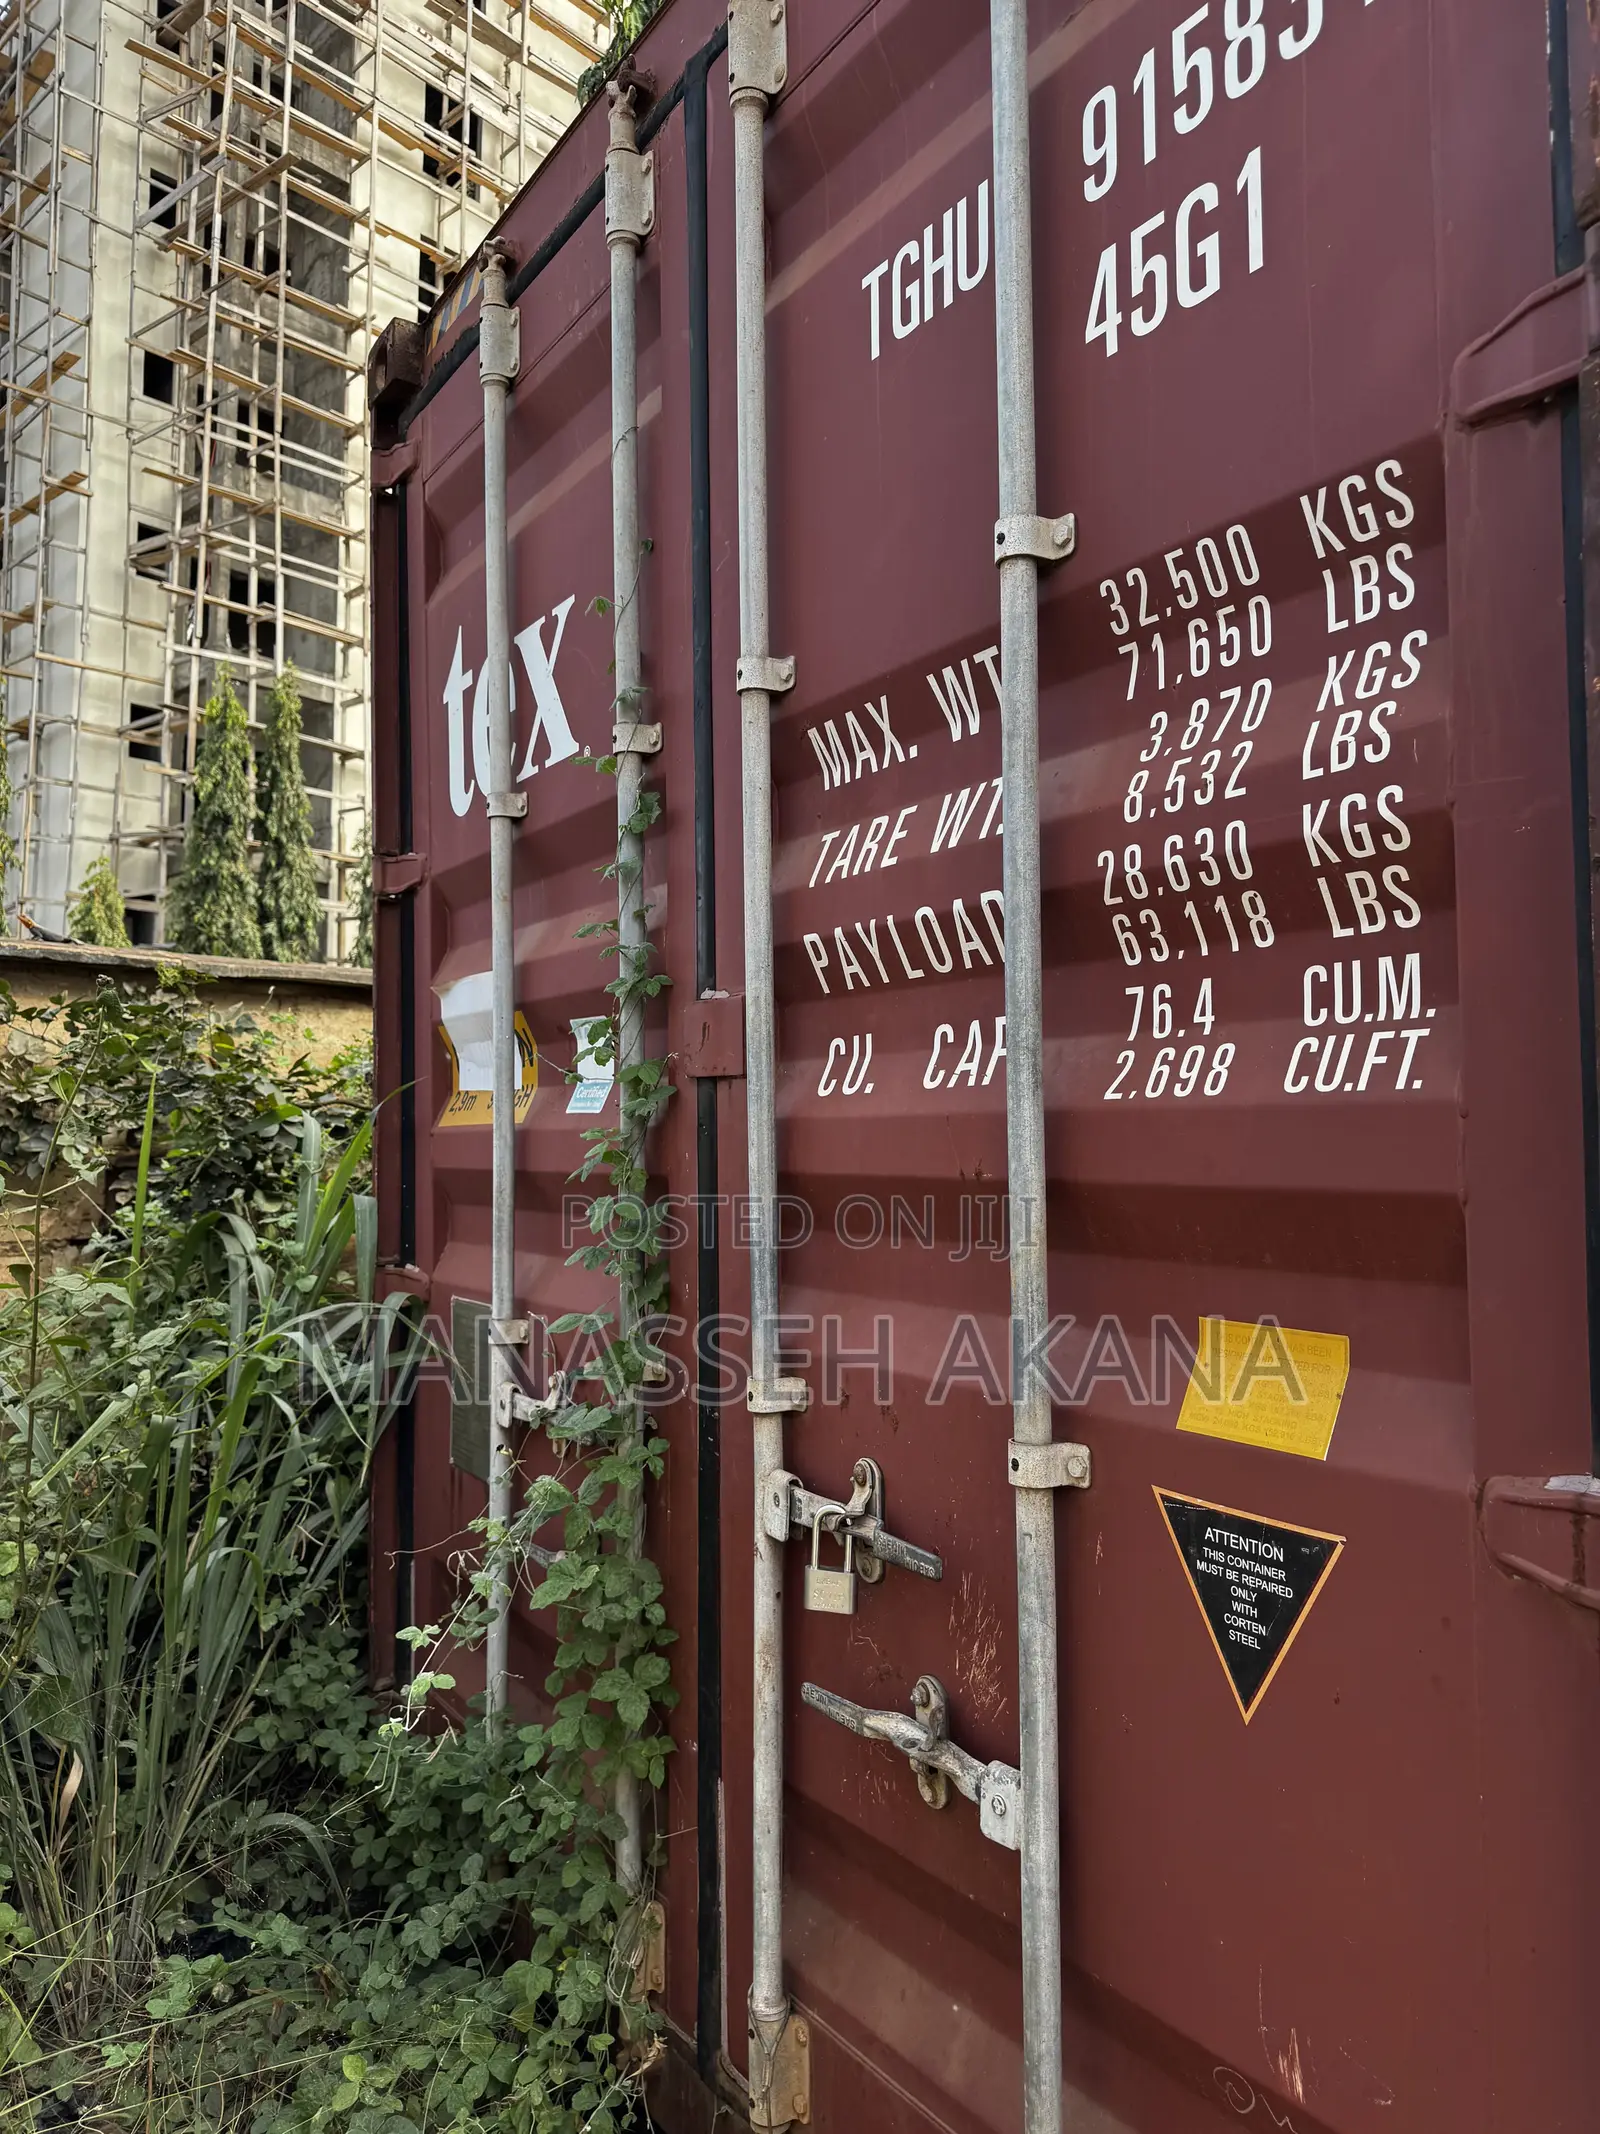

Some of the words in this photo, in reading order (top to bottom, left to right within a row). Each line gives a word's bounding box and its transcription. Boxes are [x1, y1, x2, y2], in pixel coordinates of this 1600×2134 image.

[861, 180, 989, 361] TGHU
[1085, 146, 1264, 358] 45G1
[1300, 459, 1414, 559] KGS
[1322, 542, 1416, 633] LBS
[1316, 630, 1428, 711] KGS
[807, 694, 918, 791] MAX.
[1302, 701, 1396, 781] LBS
[808, 805, 918, 888] TARE
[1301, 784, 1412, 867] KGS
[1317, 865, 1422, 938] LBS
[1125, 978, 1215, 1042] 76.4
[1303, 952, 1436, 1027] CU.M.
[818, 1033, 874, 1097] CU.
[1283, 1028, 1430, 1094] CU.FT.
[1196, 1560, 1224, 1577] MUST
[1226, 1570, 1239, 1583] BE
[1241, 1573, 1294, 1599] REPAIRED
[1203, 1547, 1225, 1563] THIS
[1227, 1554, 1287, 1582] CONTAINER
[1204, 1527, 1284, 1563] ATTENTION
[1224, 1613, 1267, 1637] CORTEN
[1230, 1585, 1258, 1602] ONLY
[1231, 1600, 1258, 1619] WITH
[1228, 1629, 1261, 1650] STEEL
